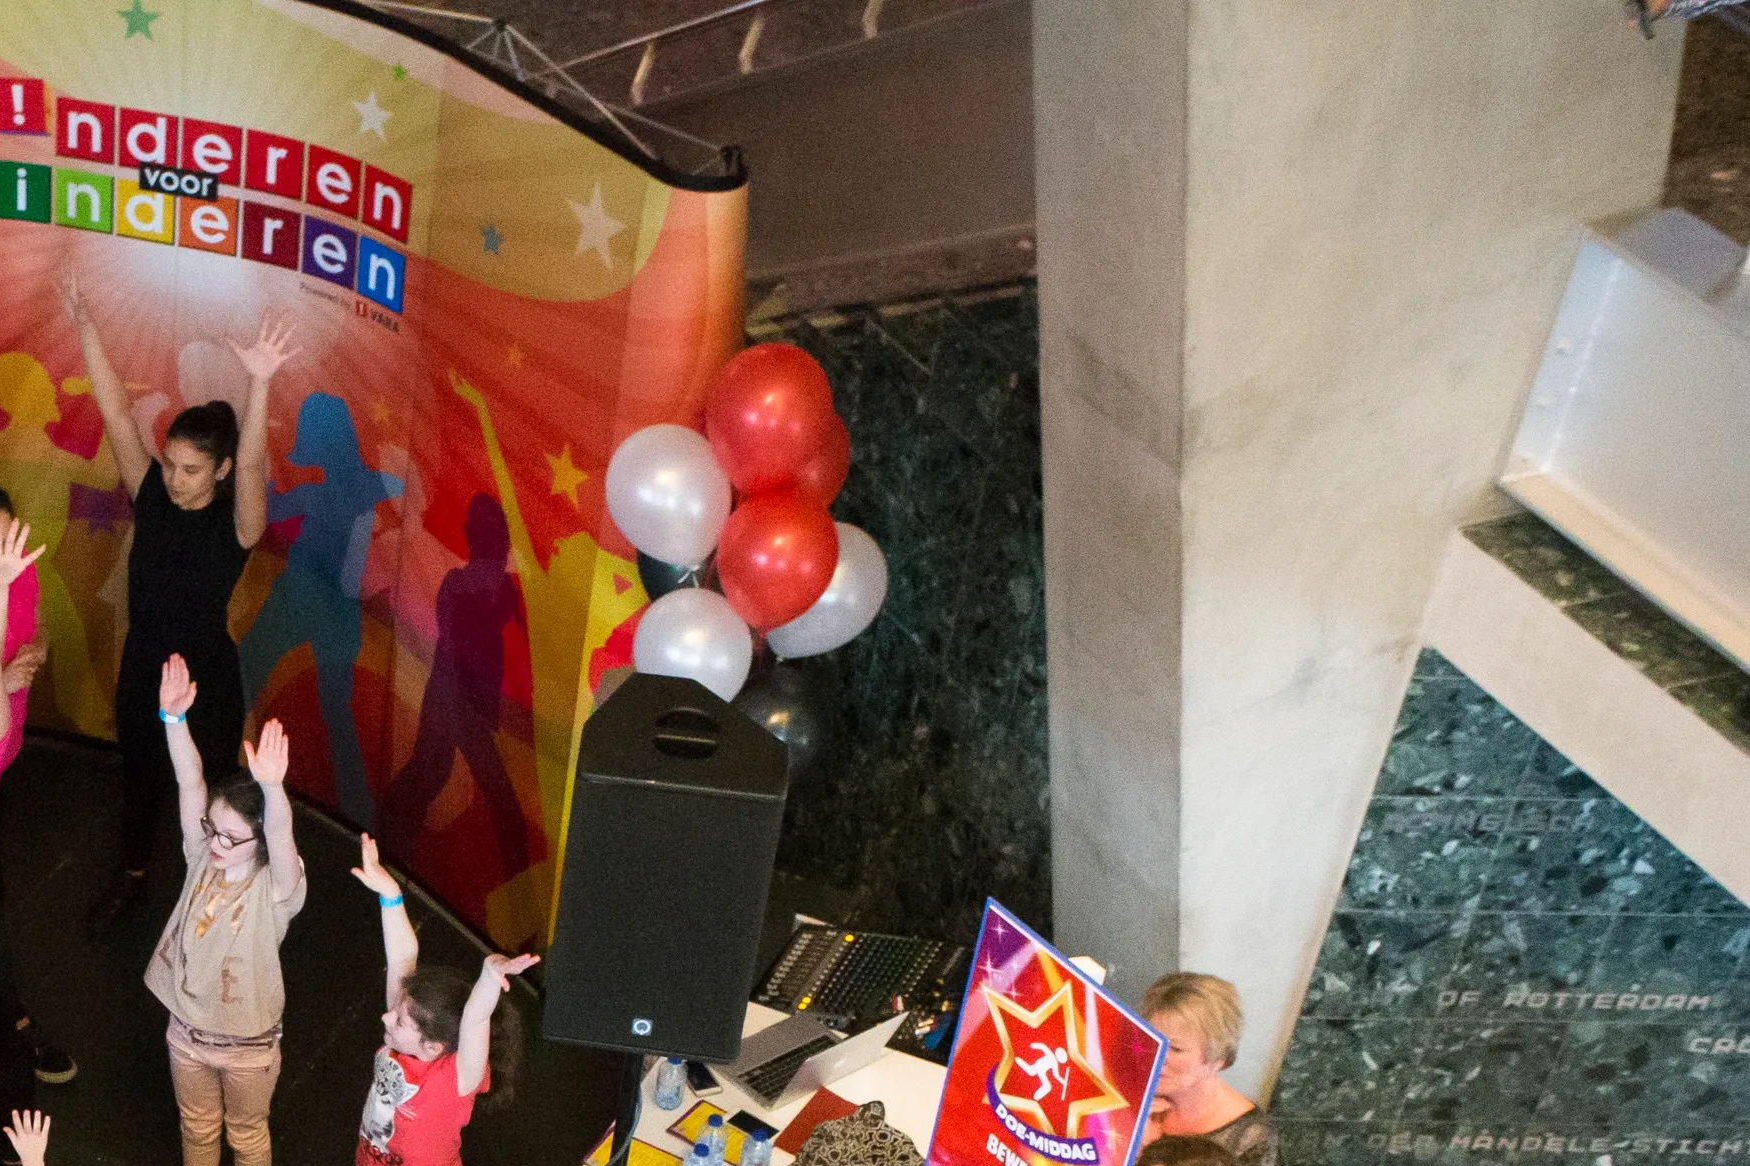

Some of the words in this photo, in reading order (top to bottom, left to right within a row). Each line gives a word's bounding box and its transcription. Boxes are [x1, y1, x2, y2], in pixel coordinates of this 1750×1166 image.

[143, 166, 214, 198] voor
[1503, 991, 1712, 1011] ROTTERDAM
[995, 1102, 1097, 1161] DOE-MIDDAG
